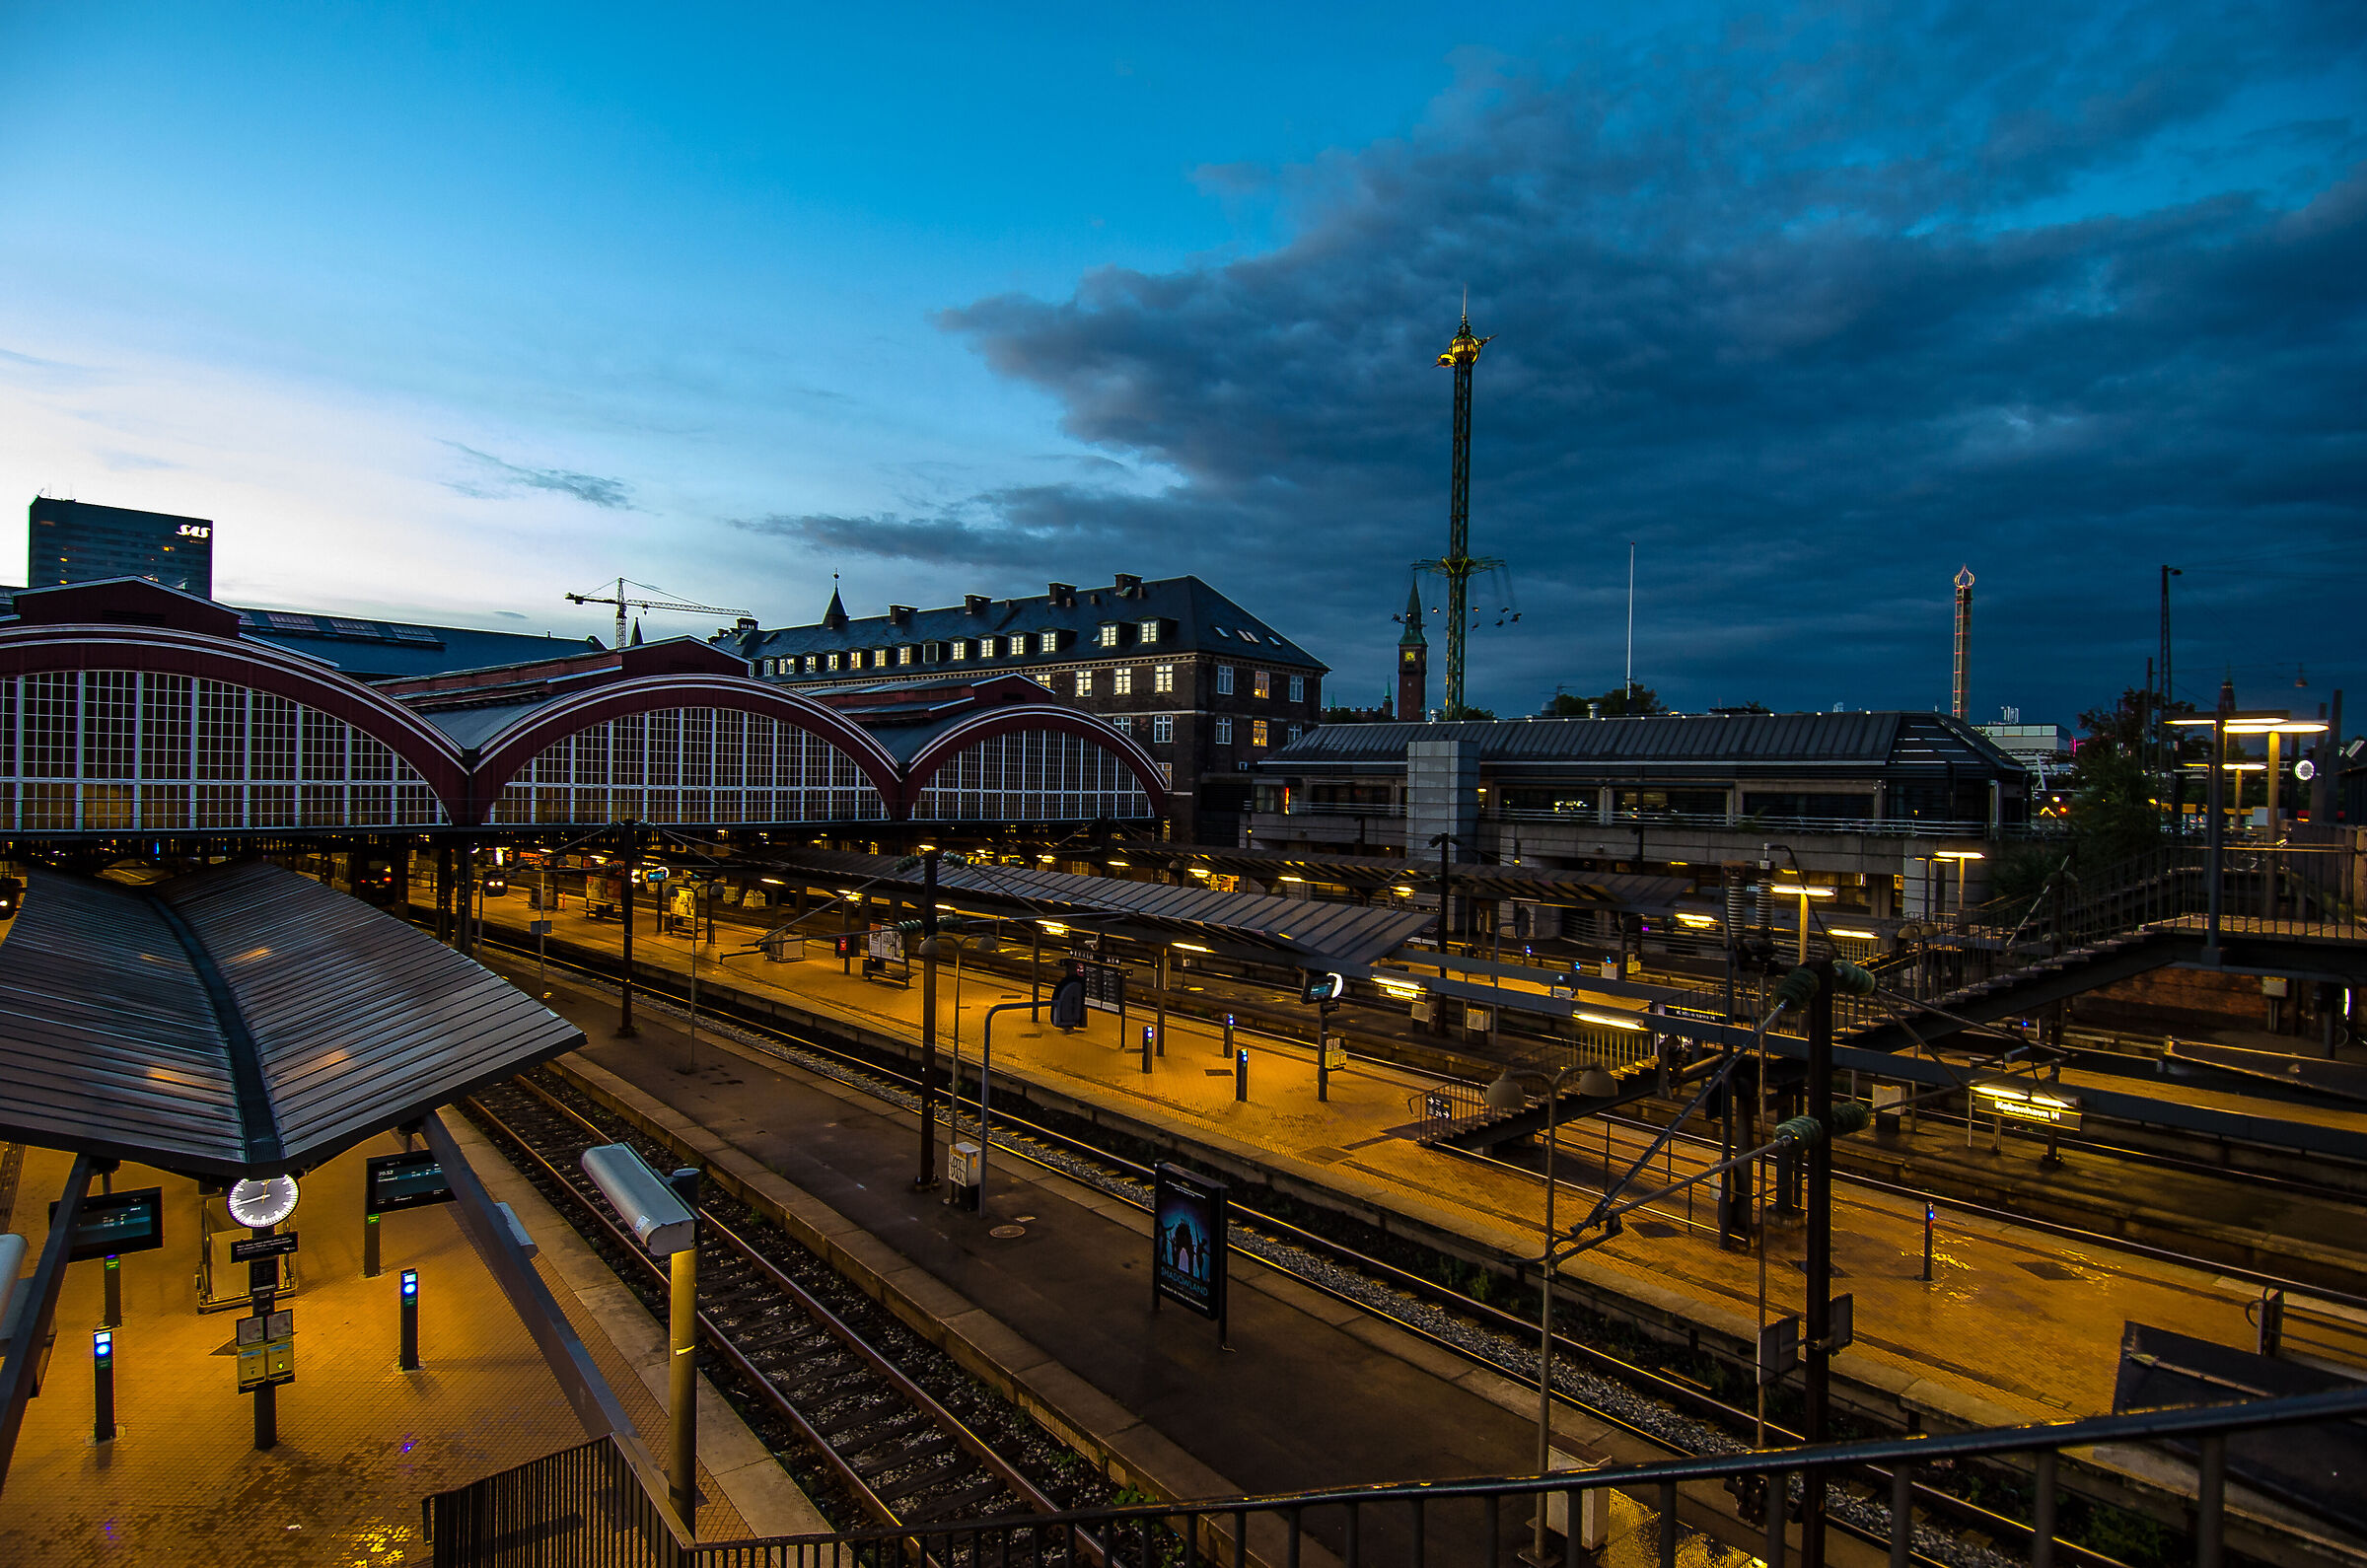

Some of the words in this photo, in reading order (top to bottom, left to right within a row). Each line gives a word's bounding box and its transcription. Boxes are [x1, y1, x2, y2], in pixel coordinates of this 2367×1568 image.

[176, 525, 211, 538] SAS
[2050, 1111, 2060, 1121] H
[1160, 1265, 1208, 1297] SHADOWLAND
